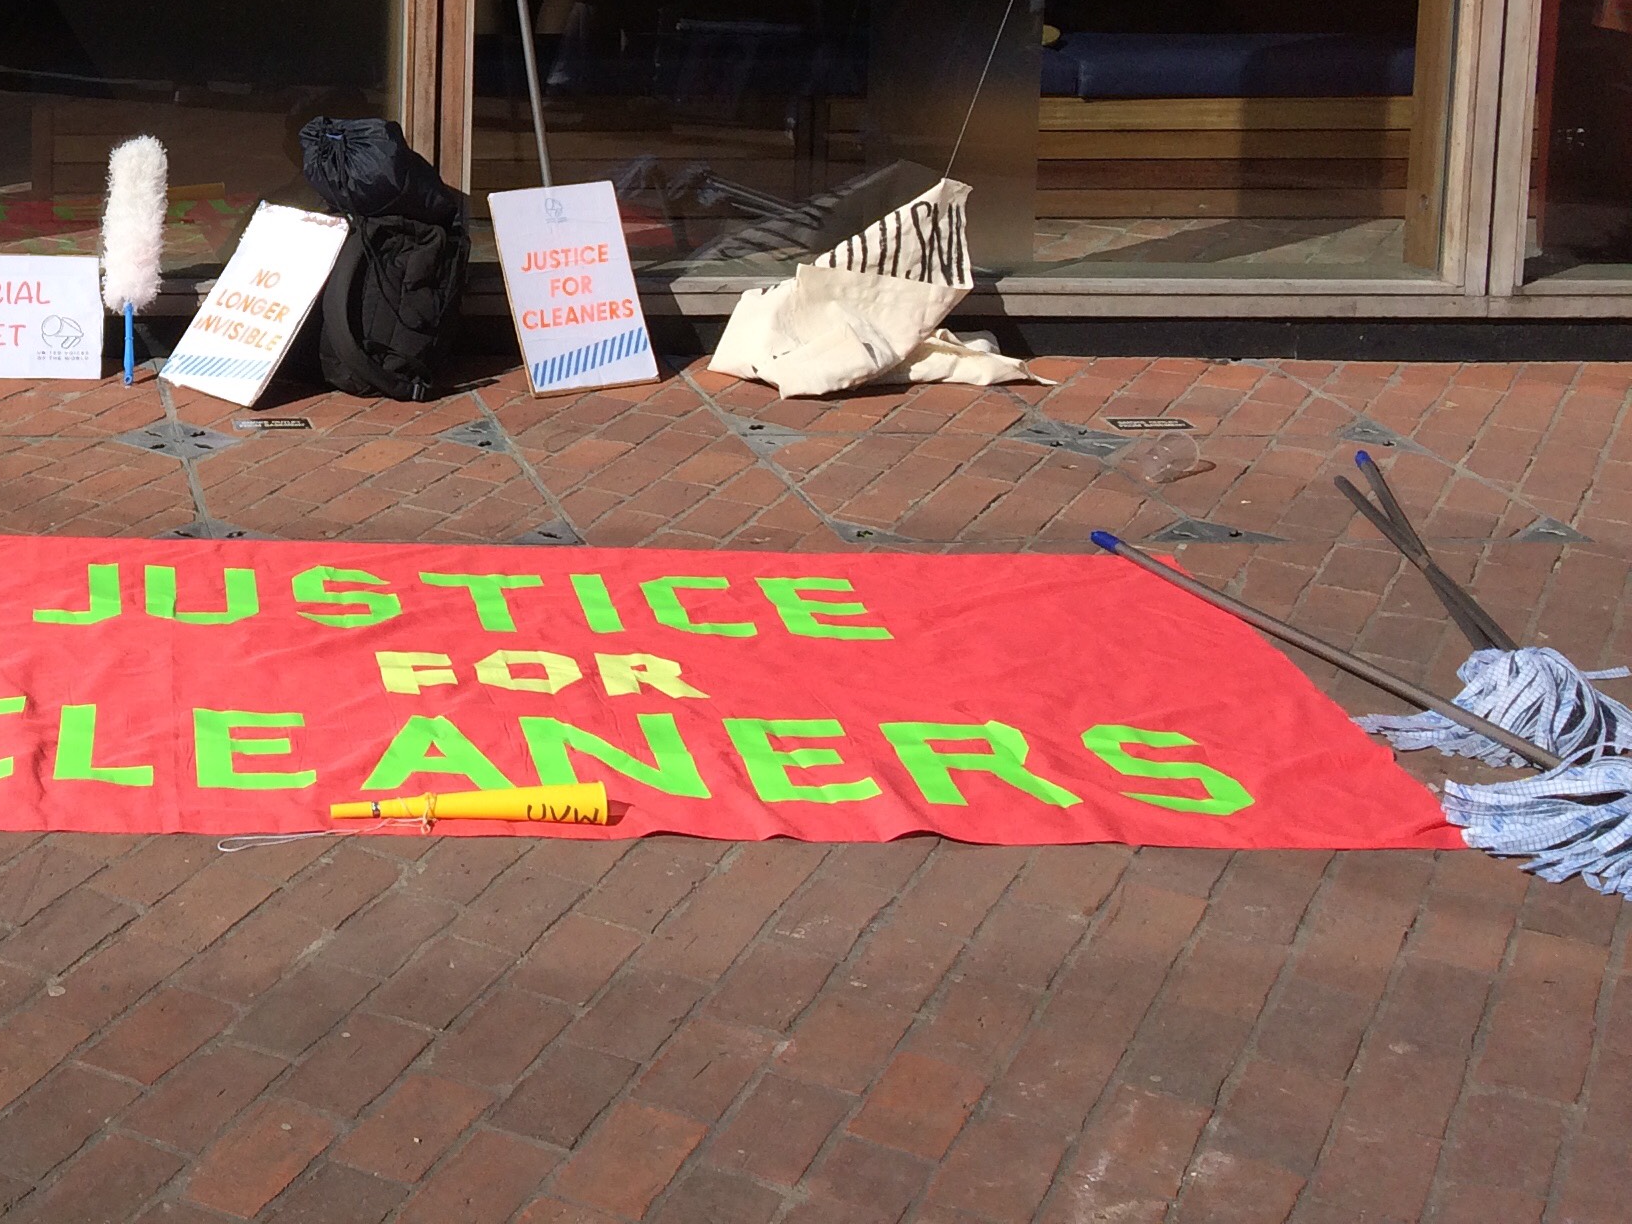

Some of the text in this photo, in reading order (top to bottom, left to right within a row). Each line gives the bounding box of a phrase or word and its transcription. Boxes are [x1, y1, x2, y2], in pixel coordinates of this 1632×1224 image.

[521, 243, 609, 273] JUSTICE
[249, 269, 281, 289] NO
[549, 275, 593, 298] FOR
[215, 288, 291, 324] LONGER
[522, 298, 635, 331] CLEANERS
[32, 562, 895, 641] JUSTICE
[374, 649, 711, 699] FOR
[526, 802, 600, 824] UVW
